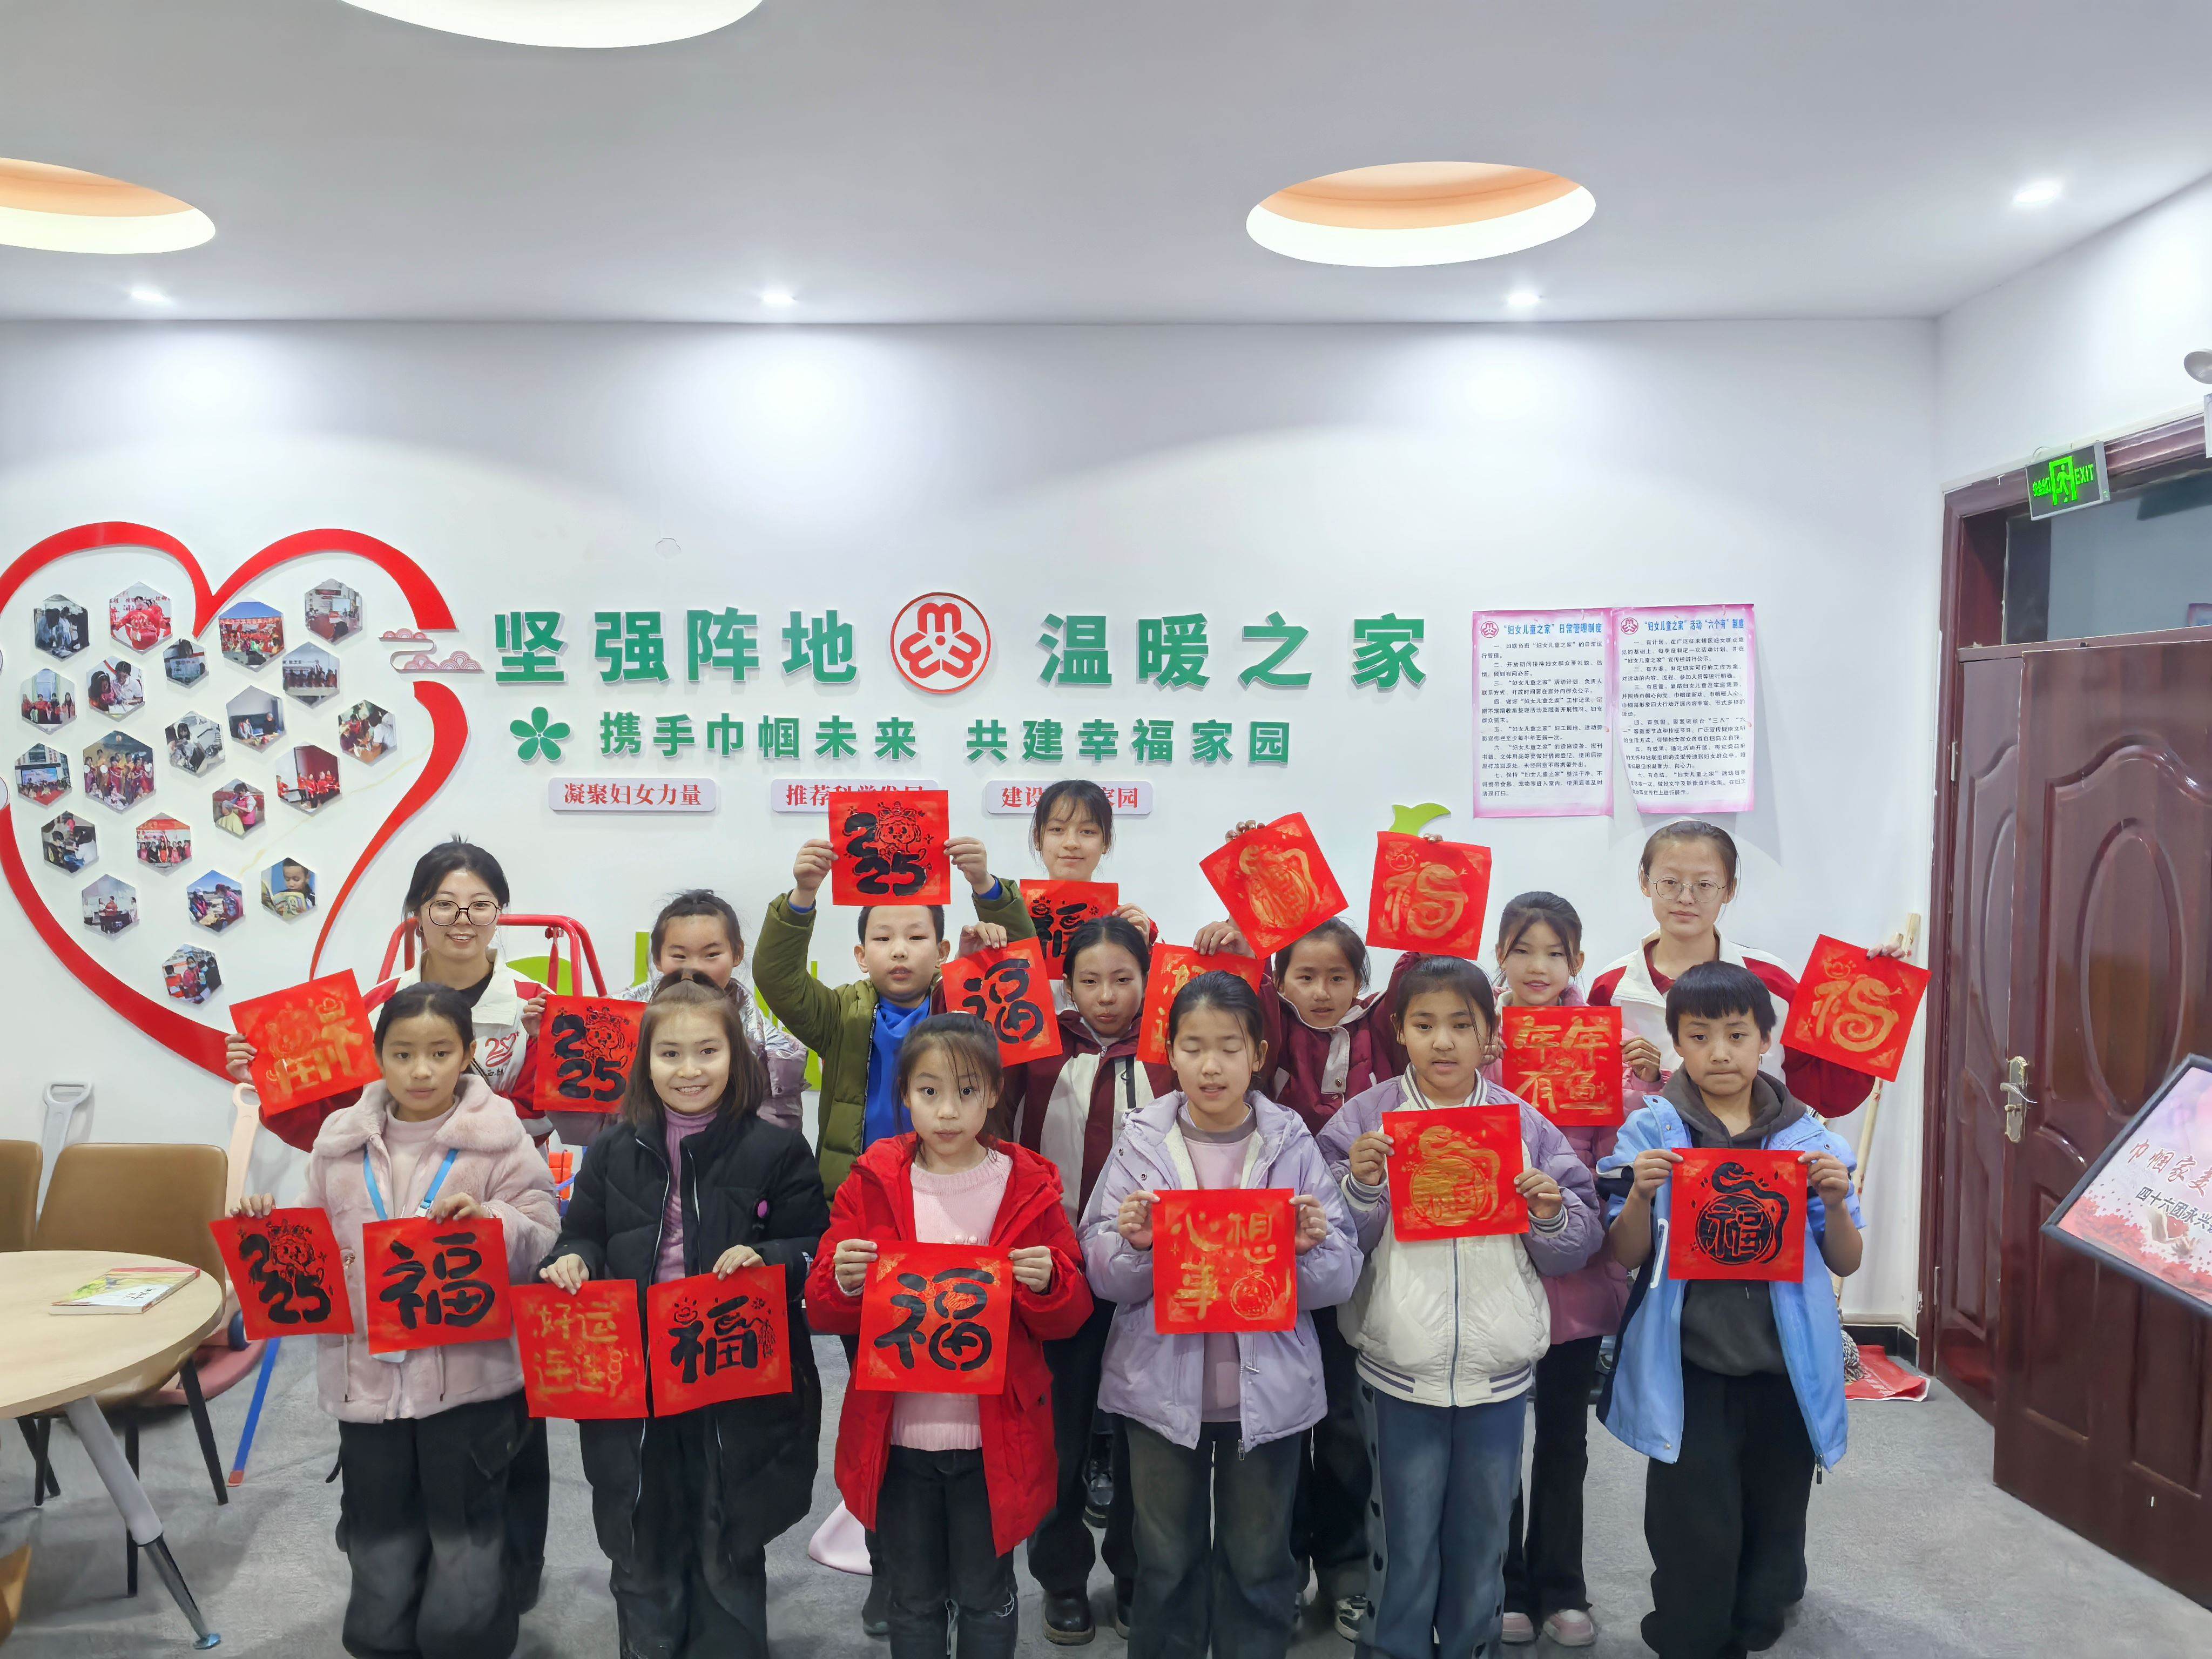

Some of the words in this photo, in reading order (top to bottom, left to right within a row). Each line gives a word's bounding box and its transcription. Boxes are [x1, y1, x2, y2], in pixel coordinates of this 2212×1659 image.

[2074, 464, 2093, 485] EXIT
[495, 607, 858, 684] 坚强阵地
[1038, 611, 1426, 689] 温暖之家
[600, 711, 916, 760] 携手巾帼未来
[967, 719, 1289, 764] 共建幸福家园
[564, 783, 702, 807] 凝聚妇女力量
[1705, 1203, 1765, 1258] 福
[2135, 1186, 2212, 1235] 四十六团永兴
[379, 1232, 495, 1330] 福
[667, 1295, 759, 1384] 福
[874, 1267, 993, 1372] 福
